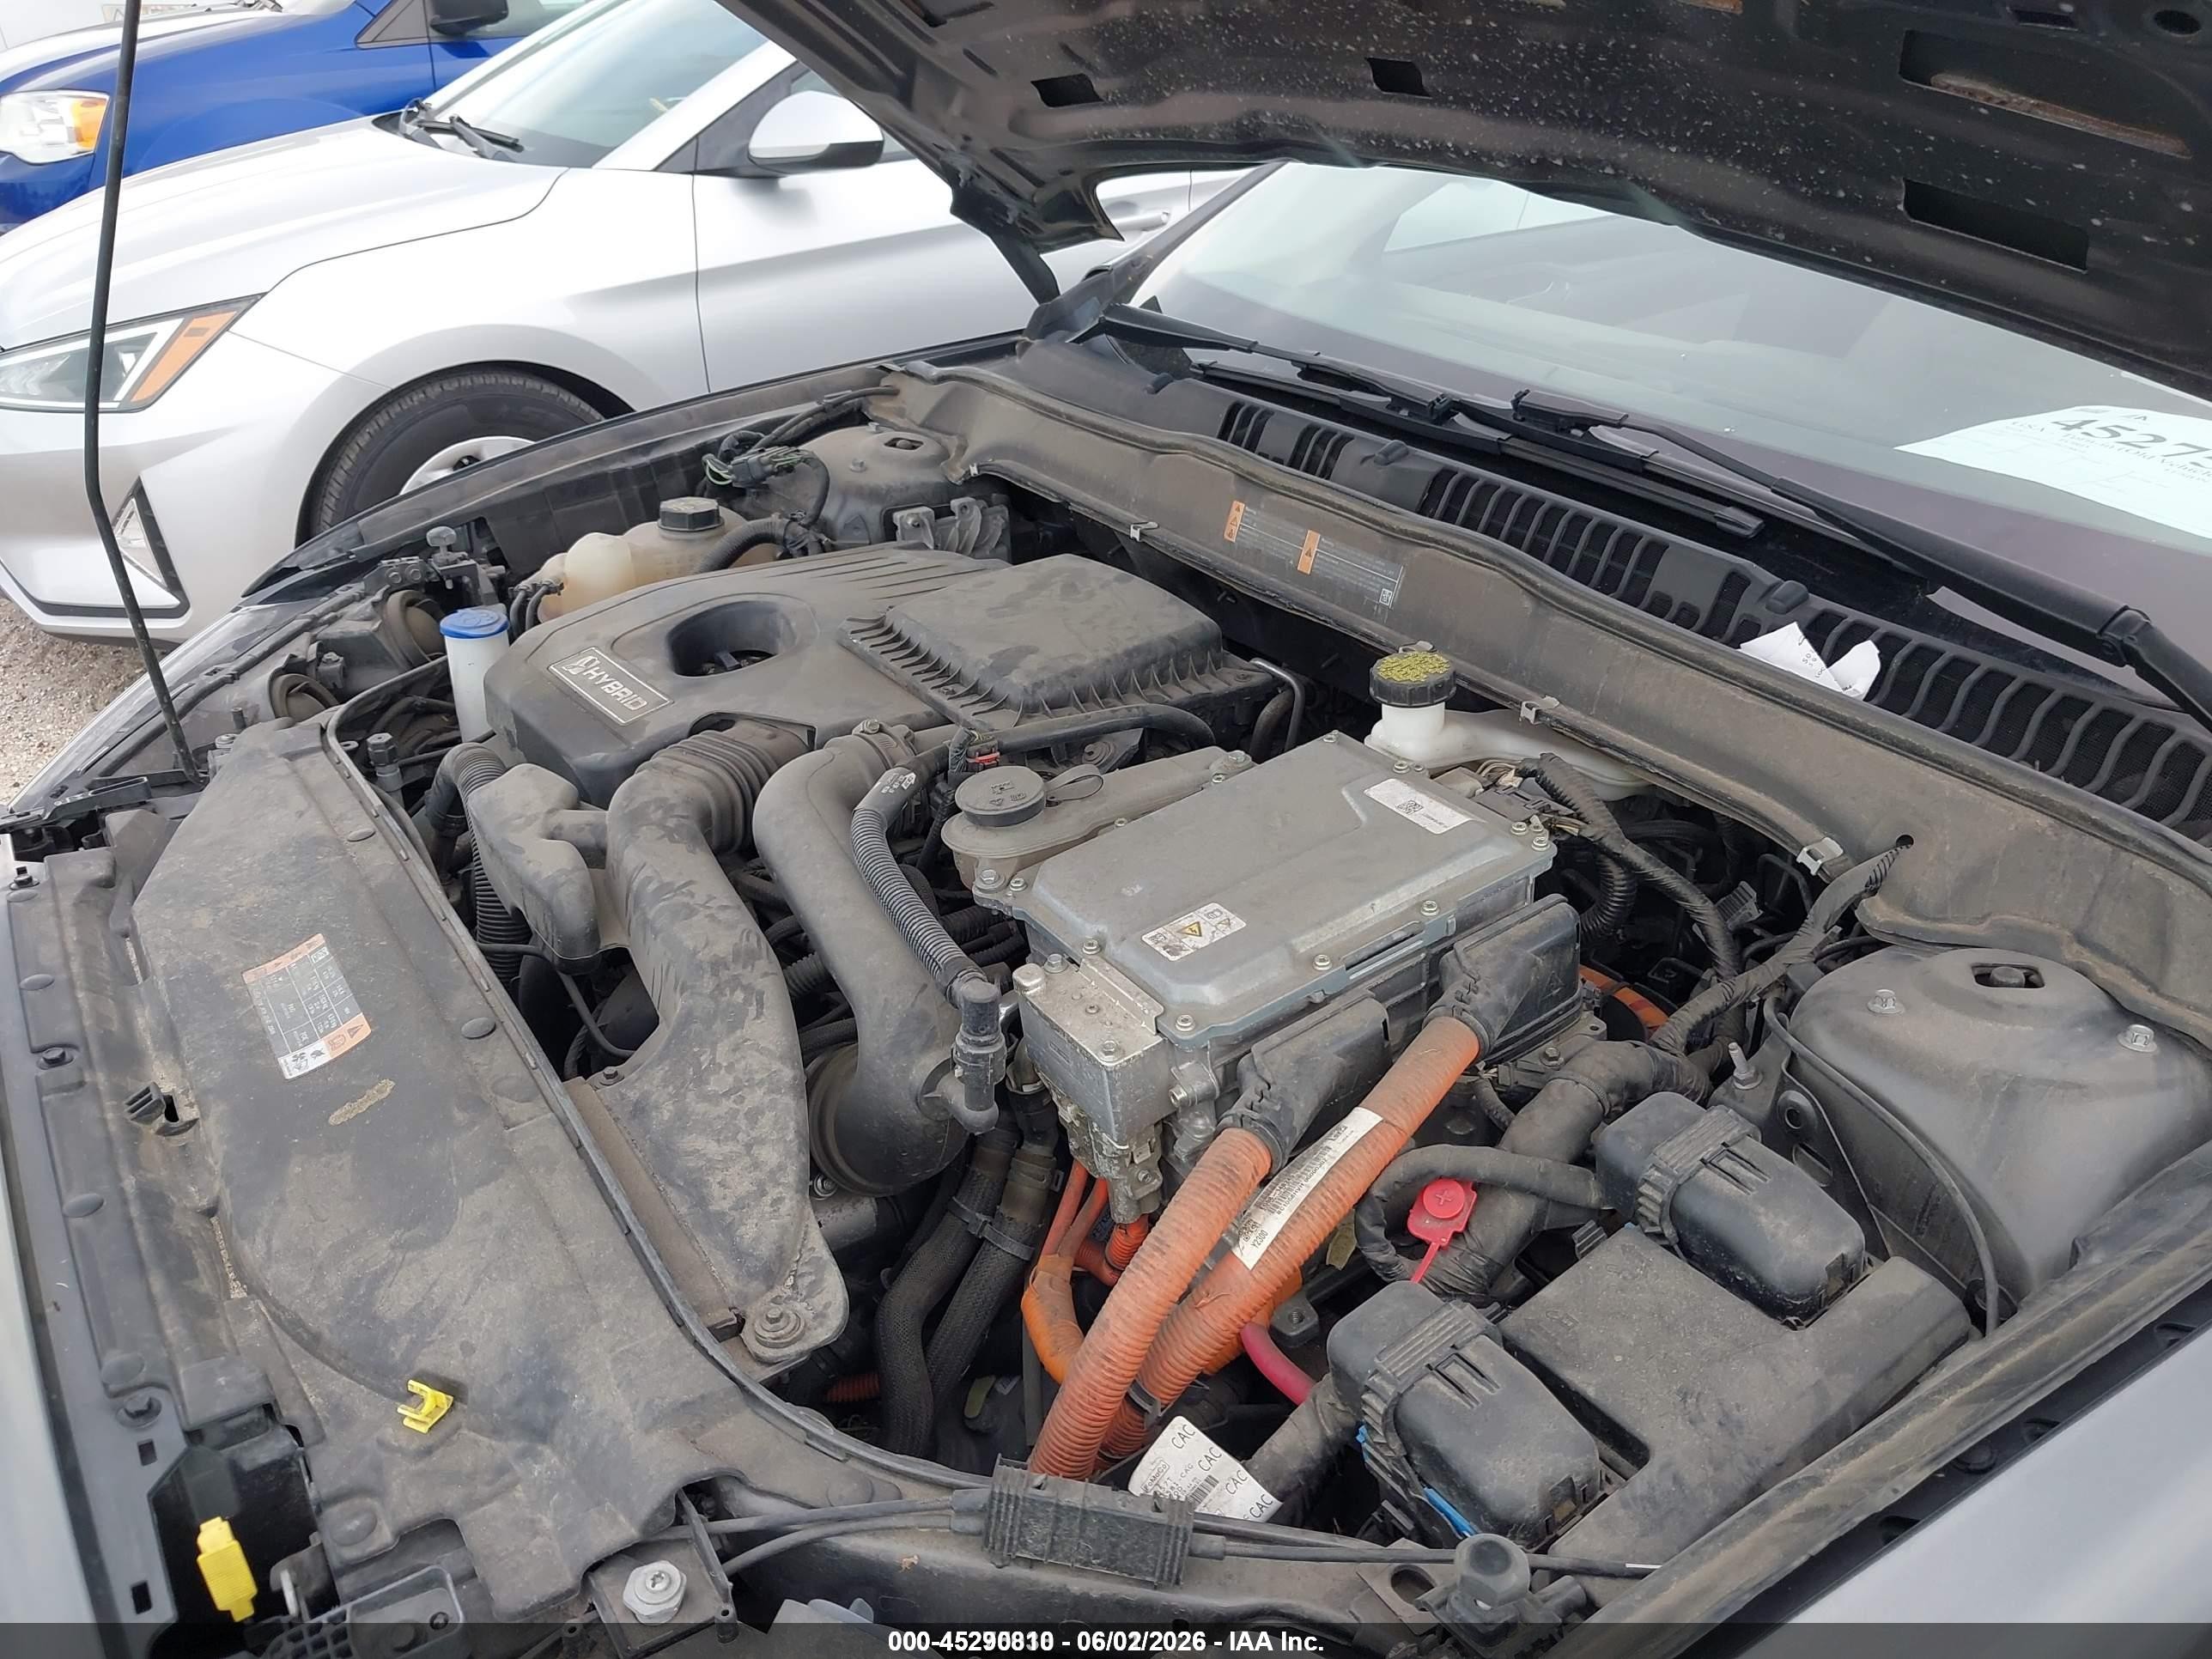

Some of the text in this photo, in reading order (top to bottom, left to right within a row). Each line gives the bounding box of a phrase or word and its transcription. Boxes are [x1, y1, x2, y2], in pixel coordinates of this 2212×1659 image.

[582, 666, 647, 711] HYBRID
[1171, 1424, 1196, 1449] CAC
[1198, 1447, 1223, 1472] CAC
[1224, 1469, 1248, 1495] CAC
[1249, 1494, 1273, 1519] CAC
